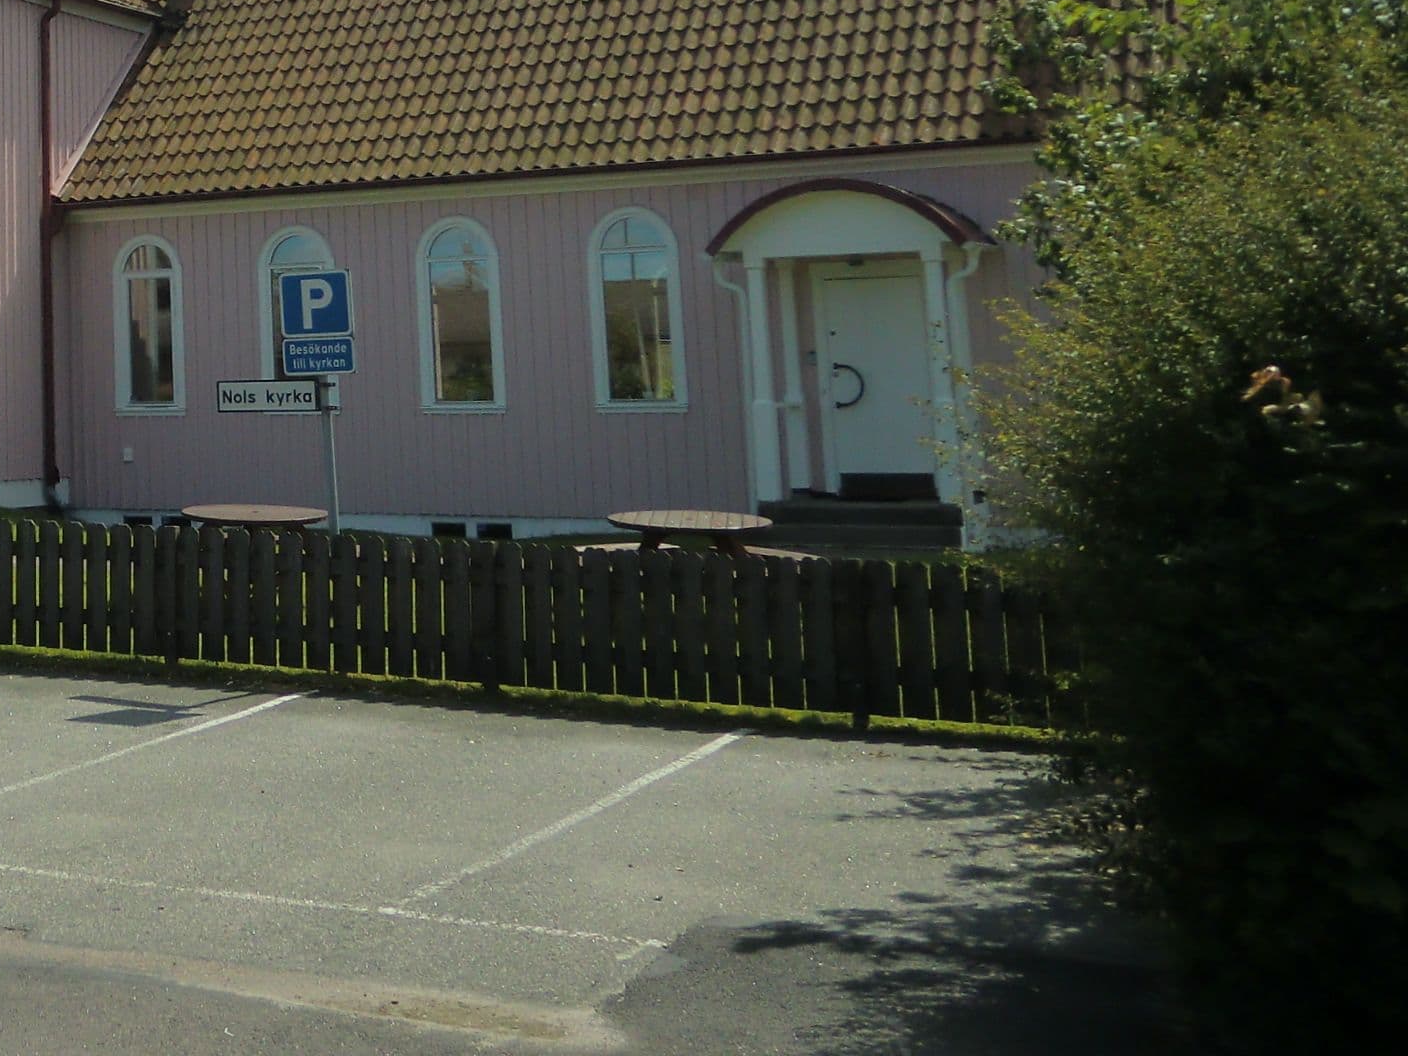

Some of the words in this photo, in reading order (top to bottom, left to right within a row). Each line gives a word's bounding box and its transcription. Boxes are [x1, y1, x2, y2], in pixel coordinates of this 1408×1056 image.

[300, 278, 333, 329] P
[289, 343, 347, 355] Besökande
[293, 358, 306, 369] till
[309, 357, 346, 370] kyrkan
[222, 390, 256, 403] Nols
[266, 390, 312, 406] kyrka
